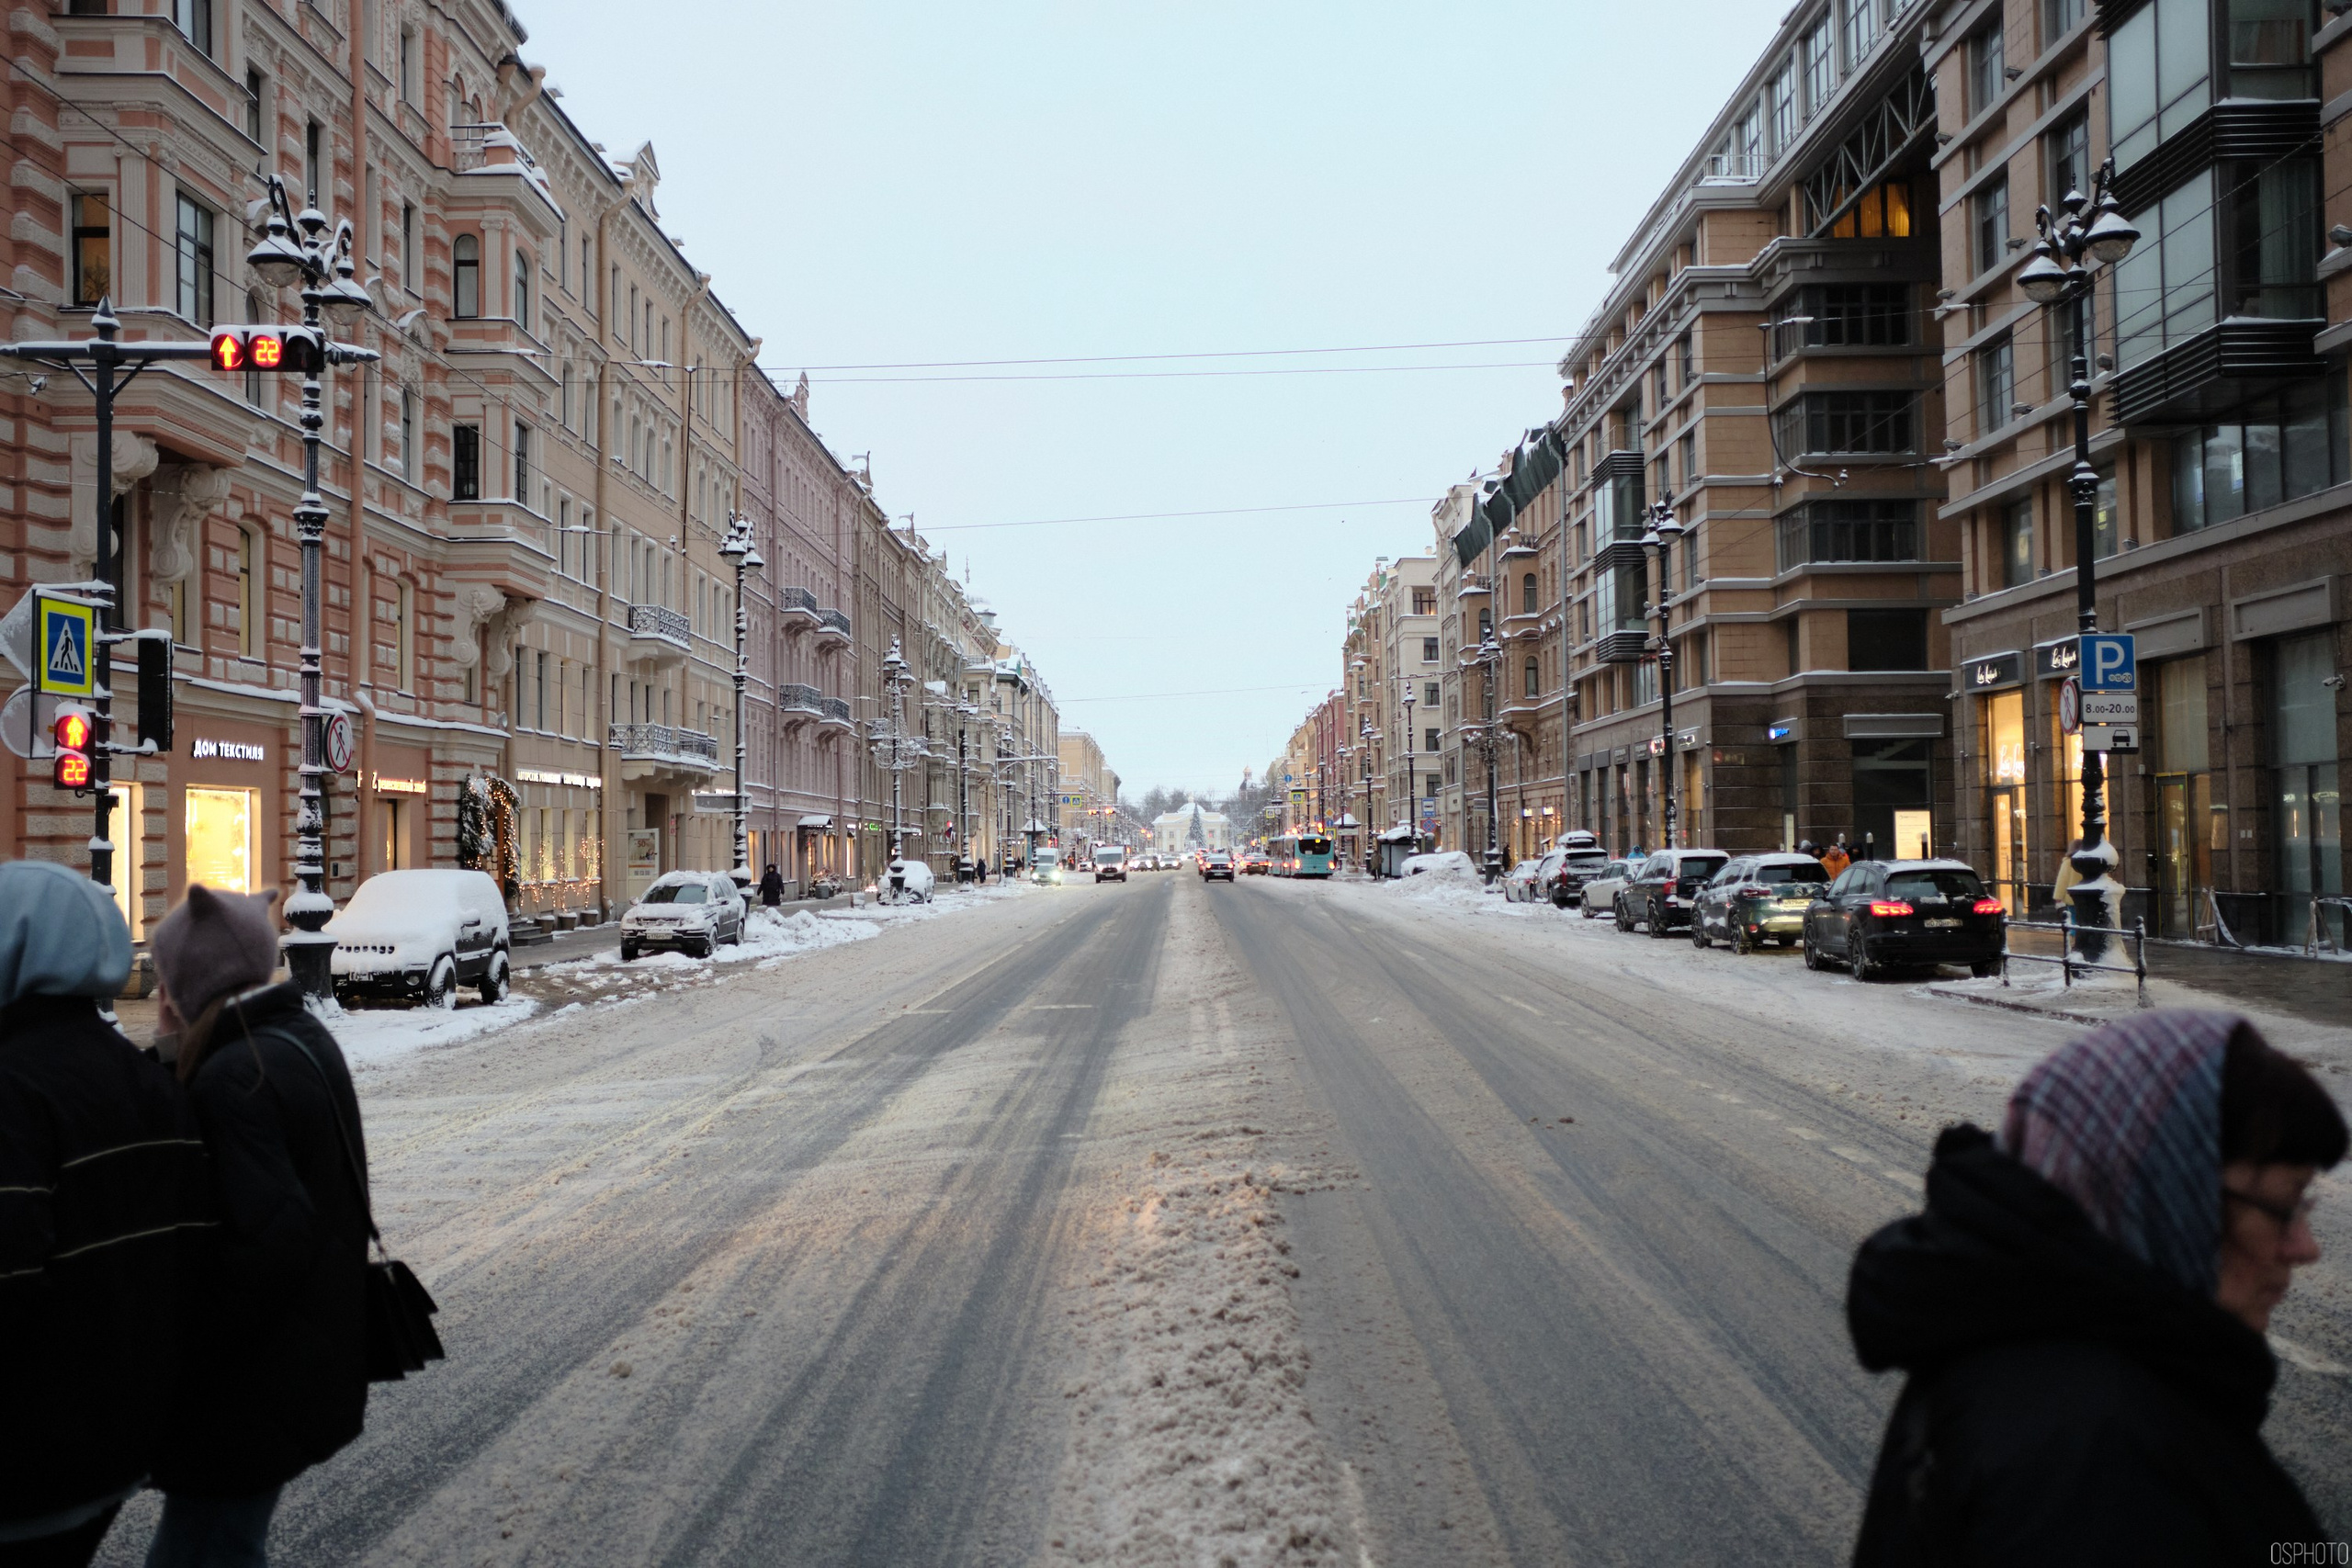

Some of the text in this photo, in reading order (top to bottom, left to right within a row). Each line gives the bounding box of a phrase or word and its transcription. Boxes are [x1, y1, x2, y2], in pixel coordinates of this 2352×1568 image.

[256, 340, 279, 363] 22
[2096, 641, 2125, 684] P
[2086, 704, 2135, 714] 8.00-20.00
[194, 740, 264, 761] ДОМ ТЕКСТИЛЯ
[63, 759, 87, 781] 22
